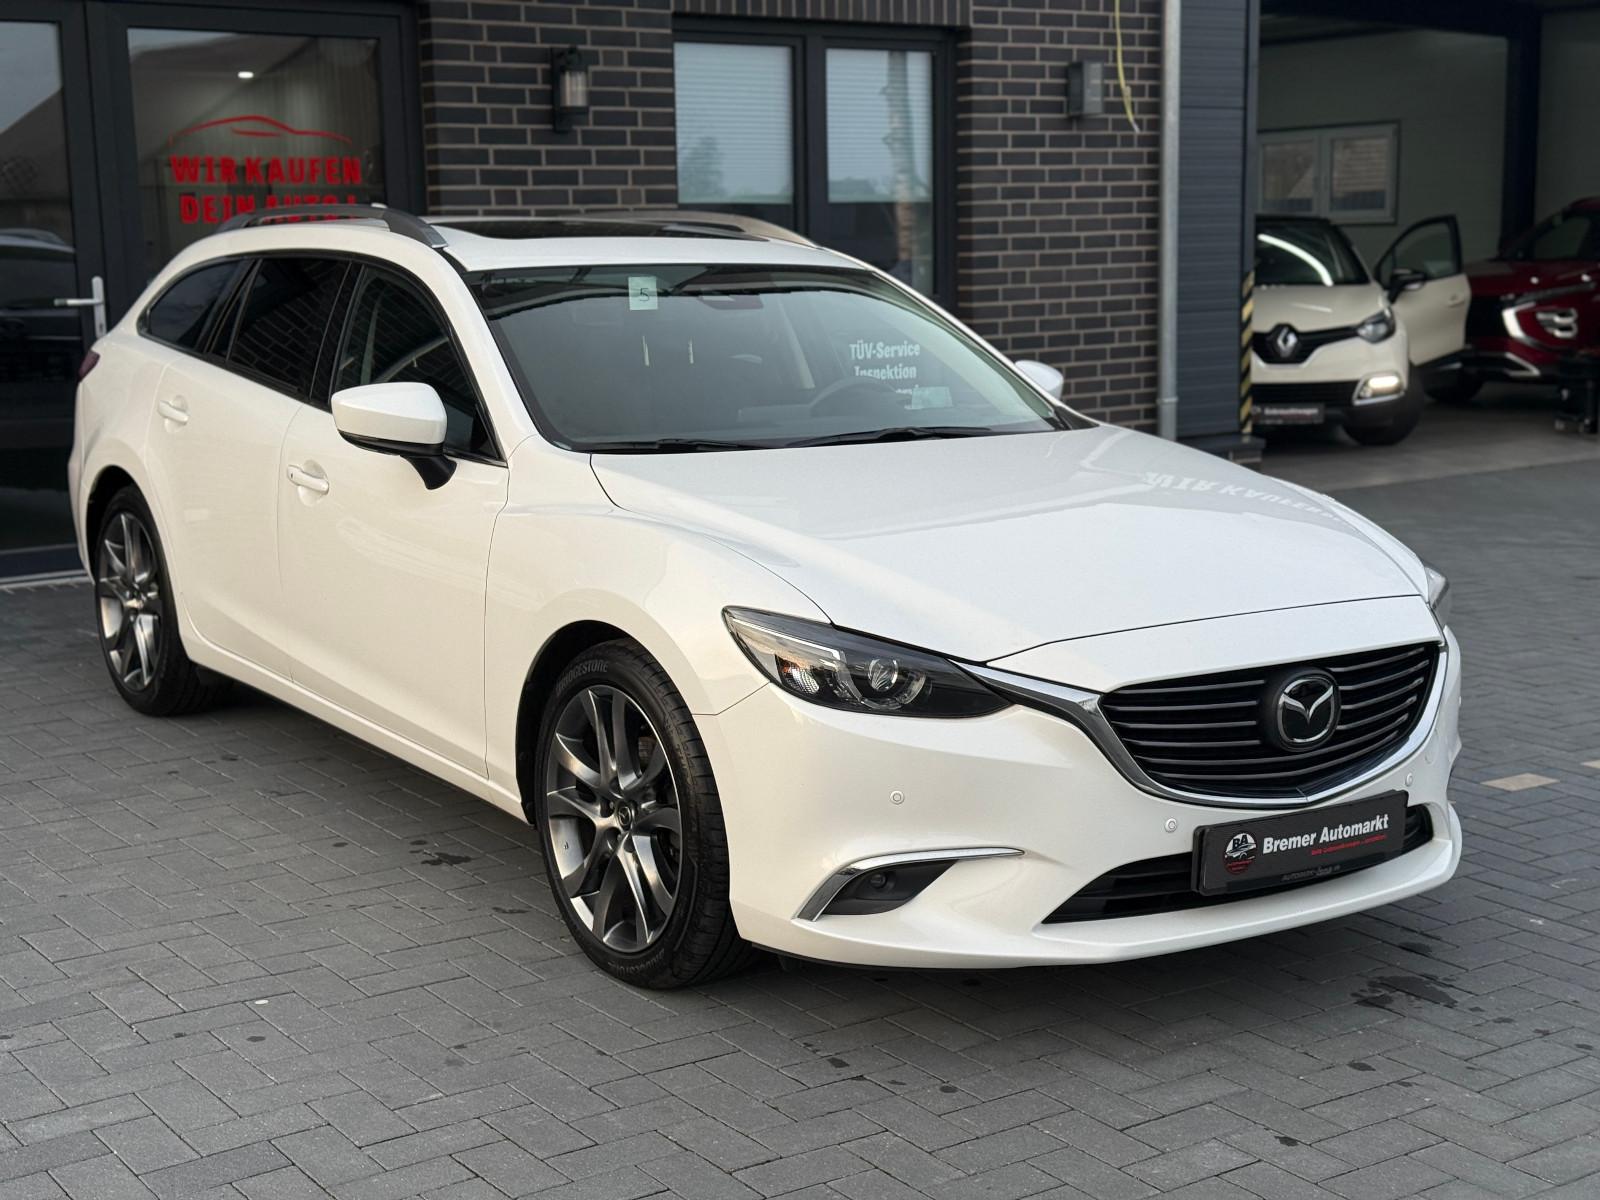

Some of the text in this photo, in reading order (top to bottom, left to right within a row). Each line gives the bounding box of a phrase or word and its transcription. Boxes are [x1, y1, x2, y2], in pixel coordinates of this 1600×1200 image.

[172, 157, 361, 184] WIR KAUFEN
[179, 194, 256, 224] DEIN
[639, 287, 650, 302] 5
[849, 339, 921, 361] TÜV-Service
[1262, 831, 1317, 854] Bremer
[1319, 814, 1390, 844] Automarkt
